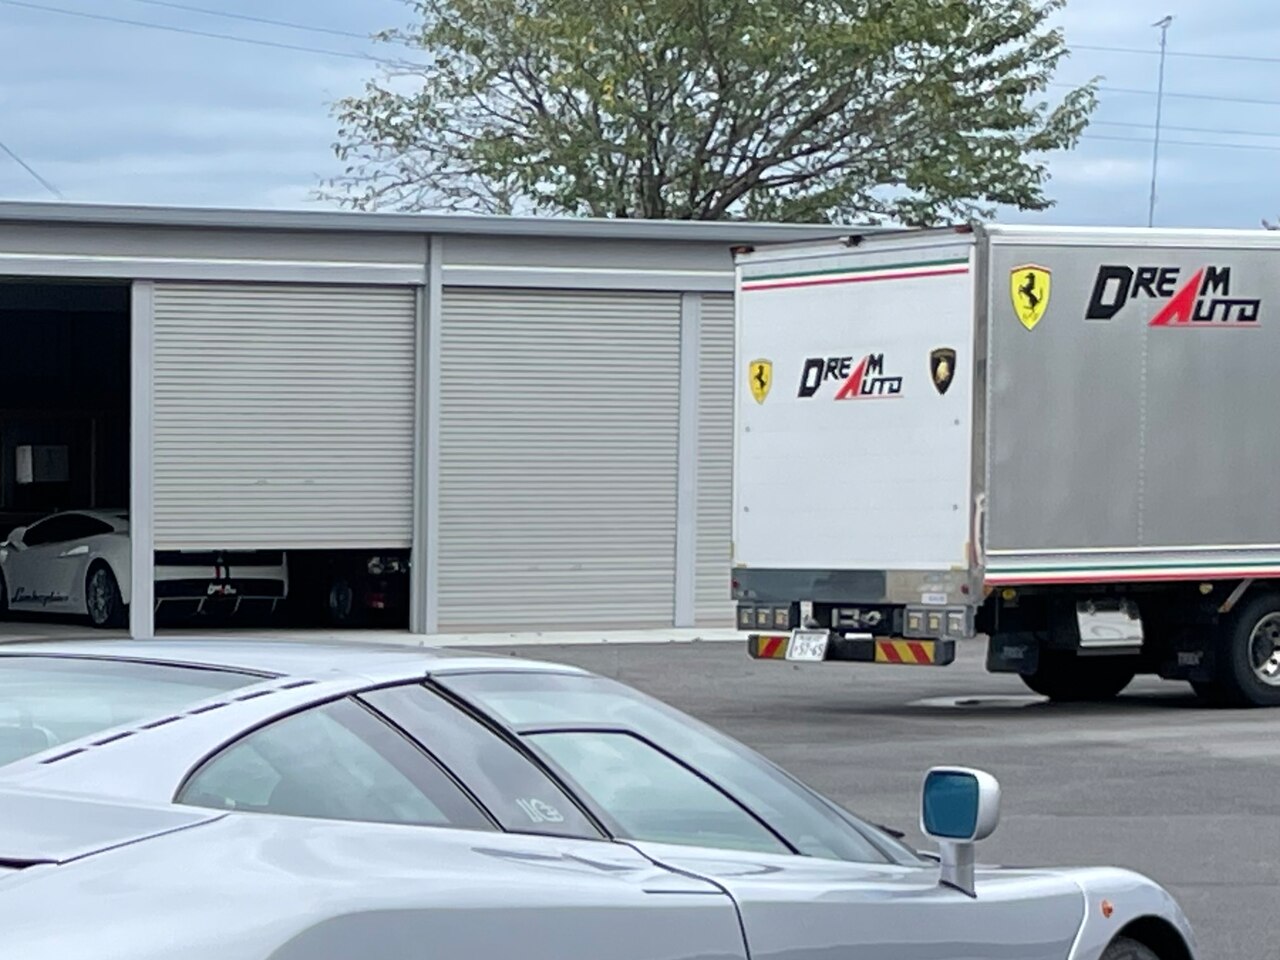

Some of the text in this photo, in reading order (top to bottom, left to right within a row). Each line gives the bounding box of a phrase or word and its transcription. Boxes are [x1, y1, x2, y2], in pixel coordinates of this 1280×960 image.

[1085, 264, 1231, 320] DREAM
[1148, 268, 1262, 327] AUTO
[797, 353, 884, 398] DREAM
[834, 356, 903, 401] AUTO
